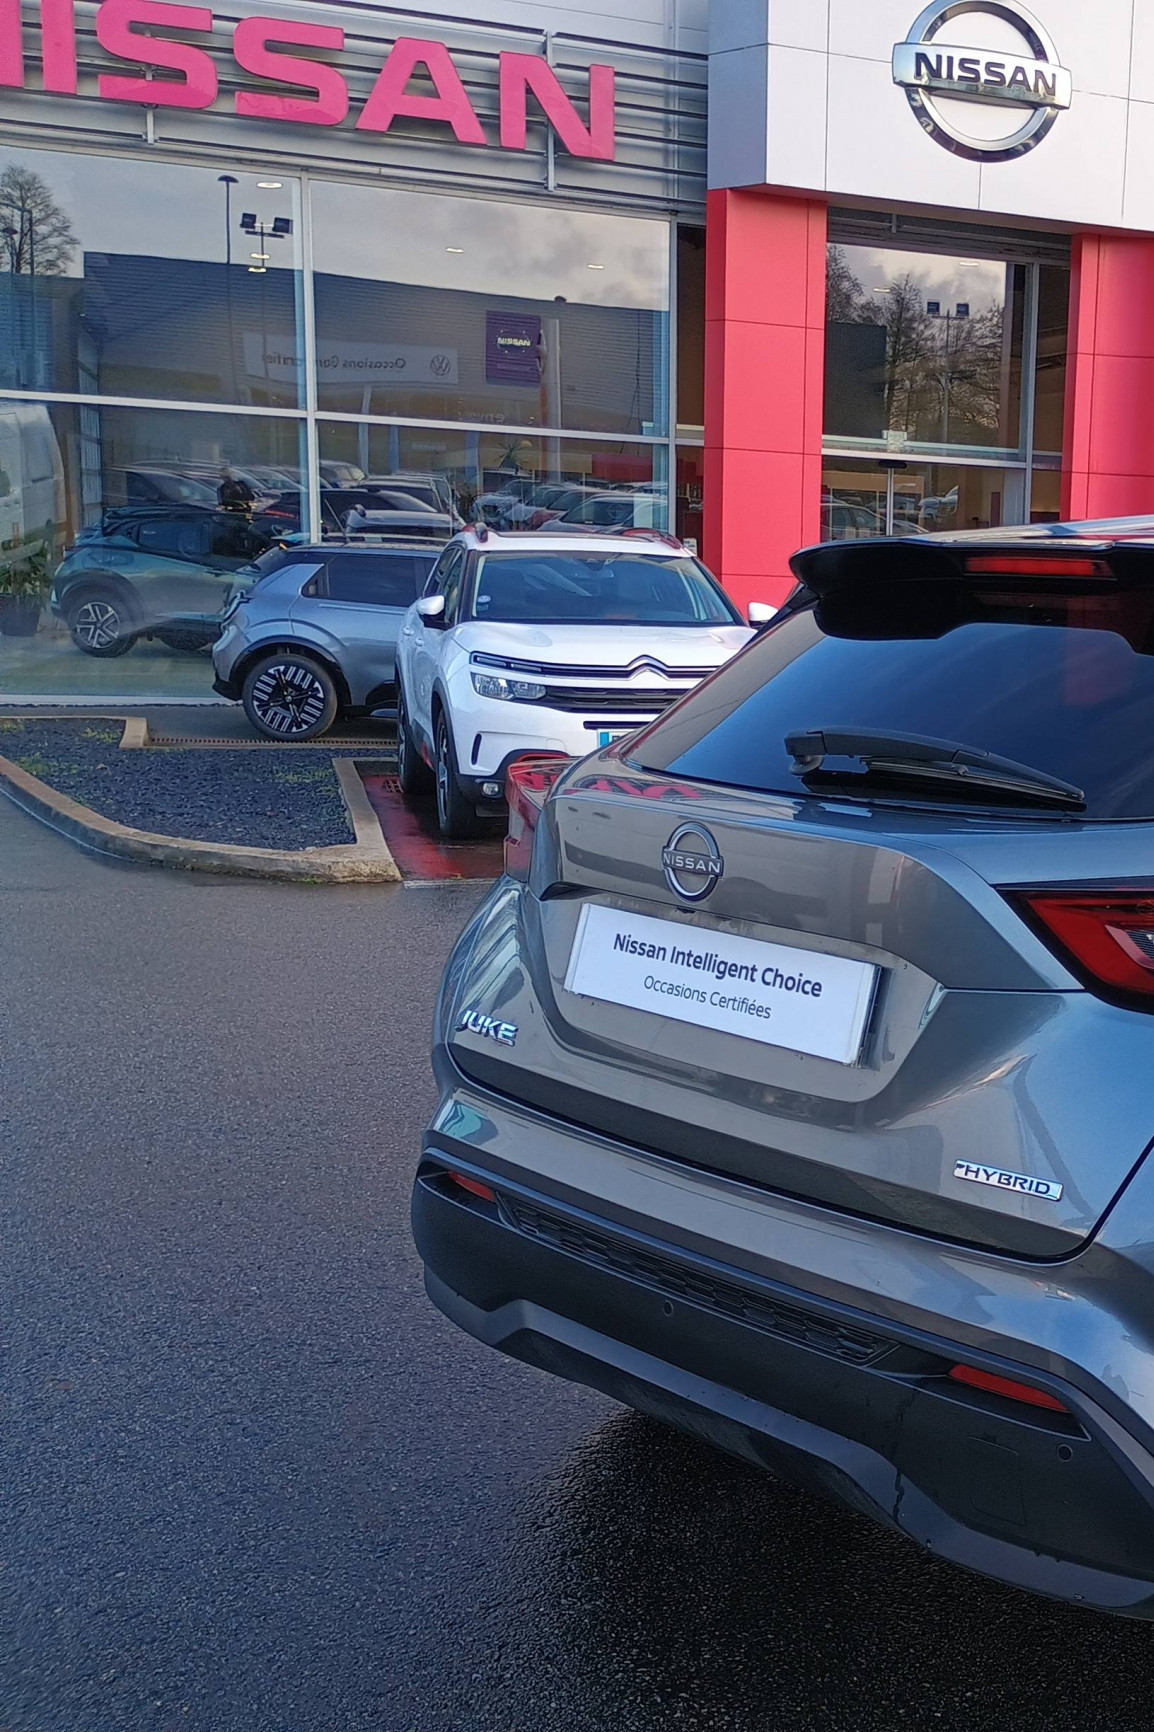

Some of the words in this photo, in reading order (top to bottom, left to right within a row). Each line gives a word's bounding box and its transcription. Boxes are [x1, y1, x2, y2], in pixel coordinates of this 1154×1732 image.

[0, 0, 614, 161] ISSAN
[915, 52, 1056, 97] NISSAN
[497, 337, 531, 347] NISSAN
[663, 852, 720, 874] NISSAN
[613, 933, 667, 961] Nissan
[670, 946, 758, 980] Intelligent
[761, 967, 823, 998] Choice
[643, 975, 707, 1003] Occasions
[709, 992, 772, 1019] Certifiées
[454, 1010, 519, 1047] JUKE
[964, 1164, 1051, 1196] HYBRID
